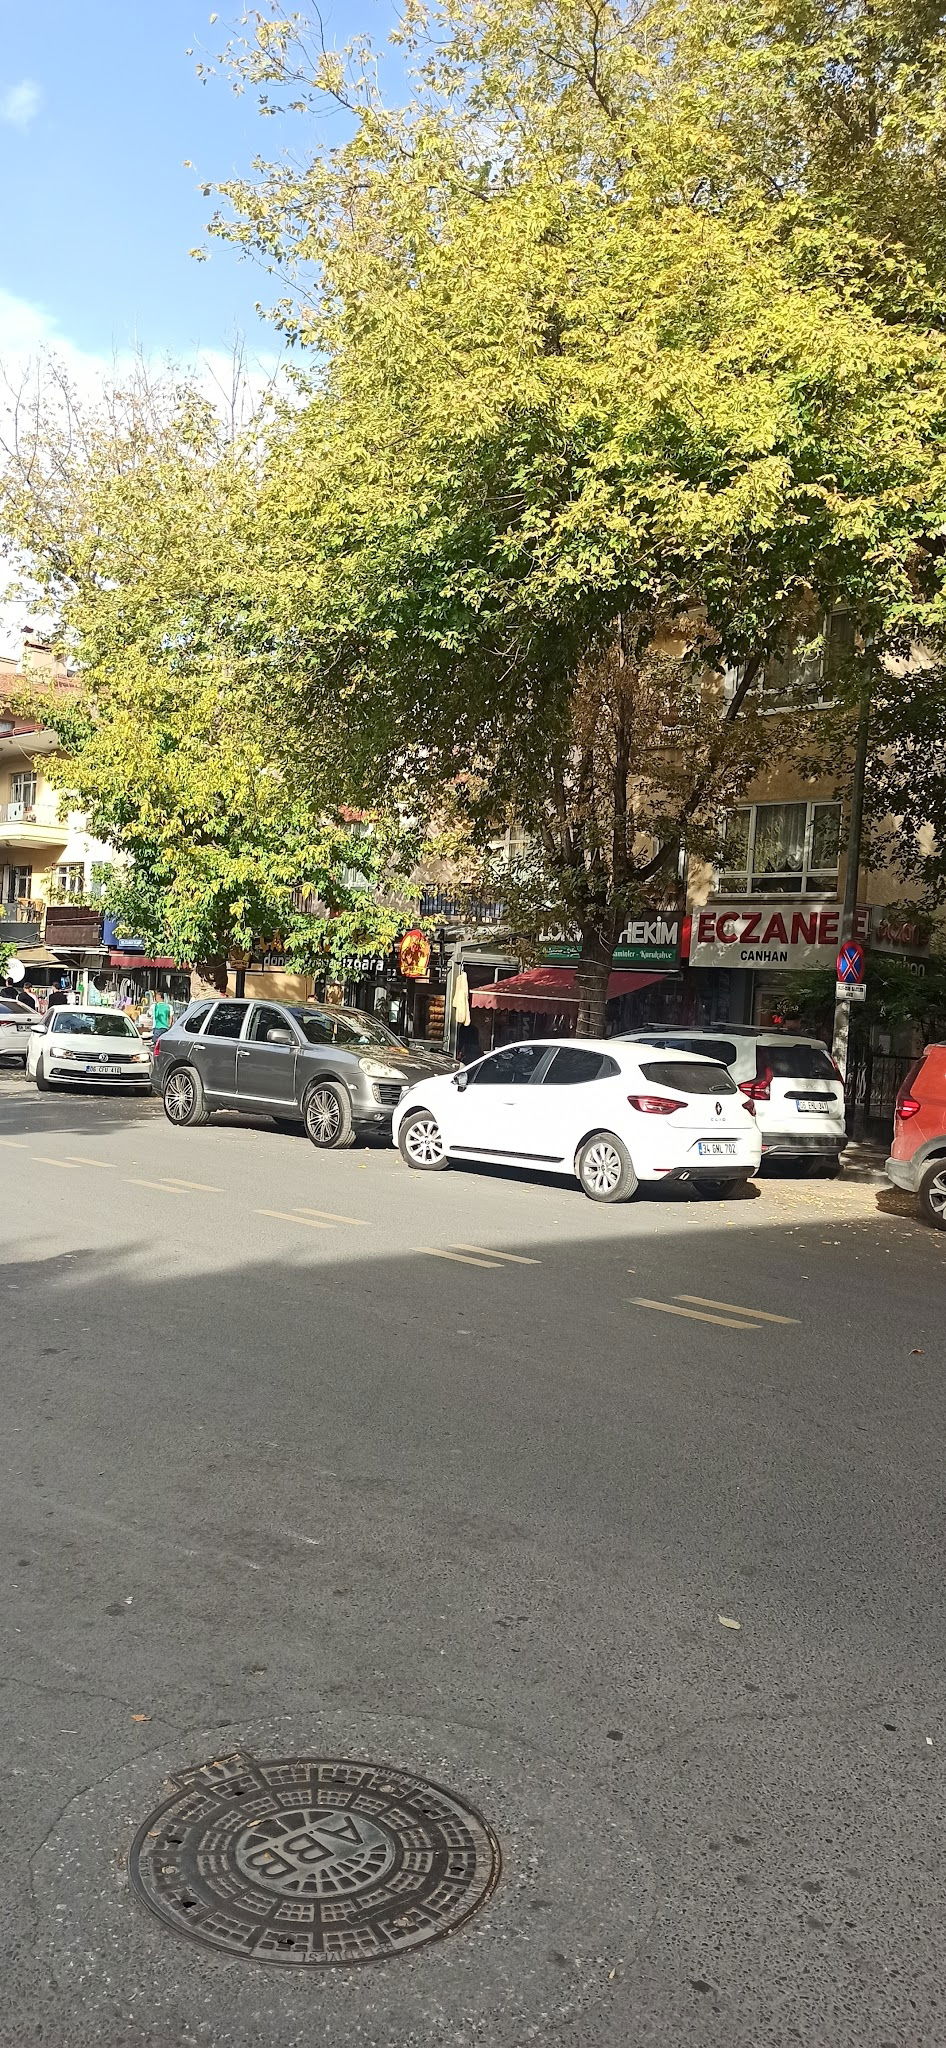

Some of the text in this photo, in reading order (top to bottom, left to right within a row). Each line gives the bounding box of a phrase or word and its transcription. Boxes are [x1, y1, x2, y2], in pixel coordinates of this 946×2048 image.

[697, 911, 840, 945] ECZANE
[740, 950, 788, 962] CANHAN
[702, 1144, 711, 1154] 34
[724, 1144, 737, 1154] 702
[245, 1815, 364, 1880] ABB
